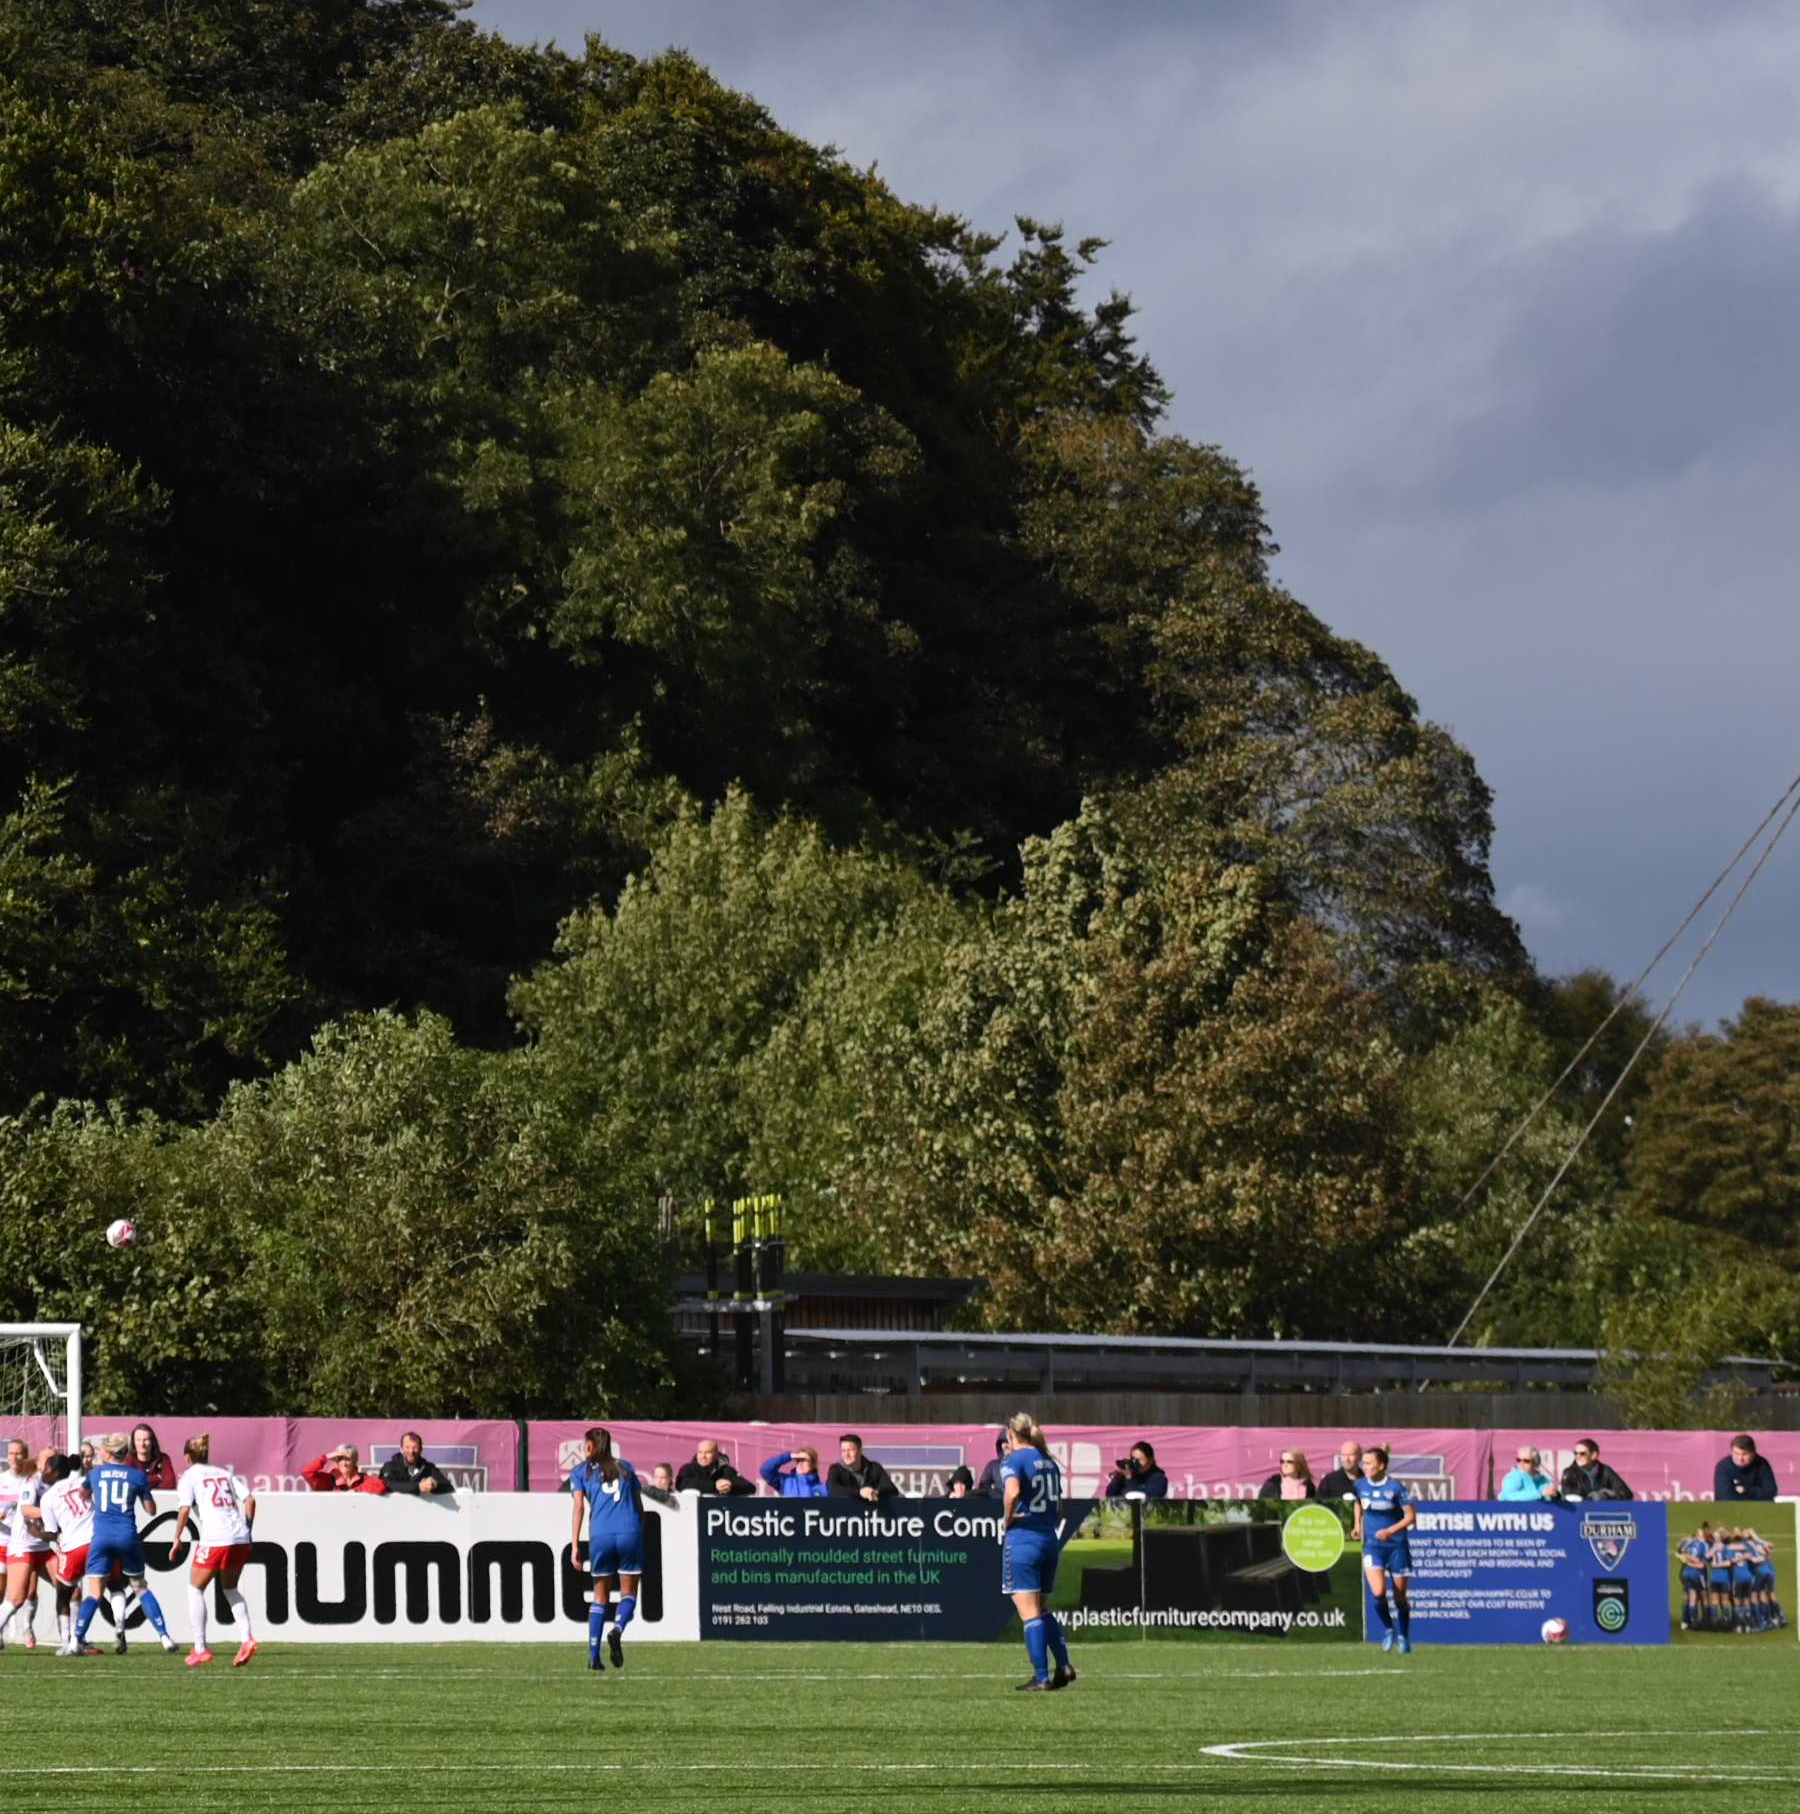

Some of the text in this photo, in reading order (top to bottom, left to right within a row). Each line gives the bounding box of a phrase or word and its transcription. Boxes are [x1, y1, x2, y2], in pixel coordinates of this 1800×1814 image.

[98, 1480, 129, 1513] 14
[203, 1477, 235, 1508] 23
[1029, 1474, 1058, 1513] 24
[707, 1509, 1067, 1544] Plastic Furniture Compy
[1407, 1512, 1555, 1532] ERTISE WITH US
[1583, 1525, 1634, 1537] DURHAM
[711, 1548, 968, 1566] Rotationally moulded street furniture
[711, 1569, 941, 1585] and bins manufactured in the UK
[712, 1604, 732, 1614] Nest
[733, 1604, 756, 1615] Road,
[758, 1603, 785, 1616] Felling
[786, 1603, 824, 1614] Industrial
[1051, 1606, 1346, 1631] w.plasticfurniturecompany.co.uk
[712, 1615, 732, 1625] 0191
